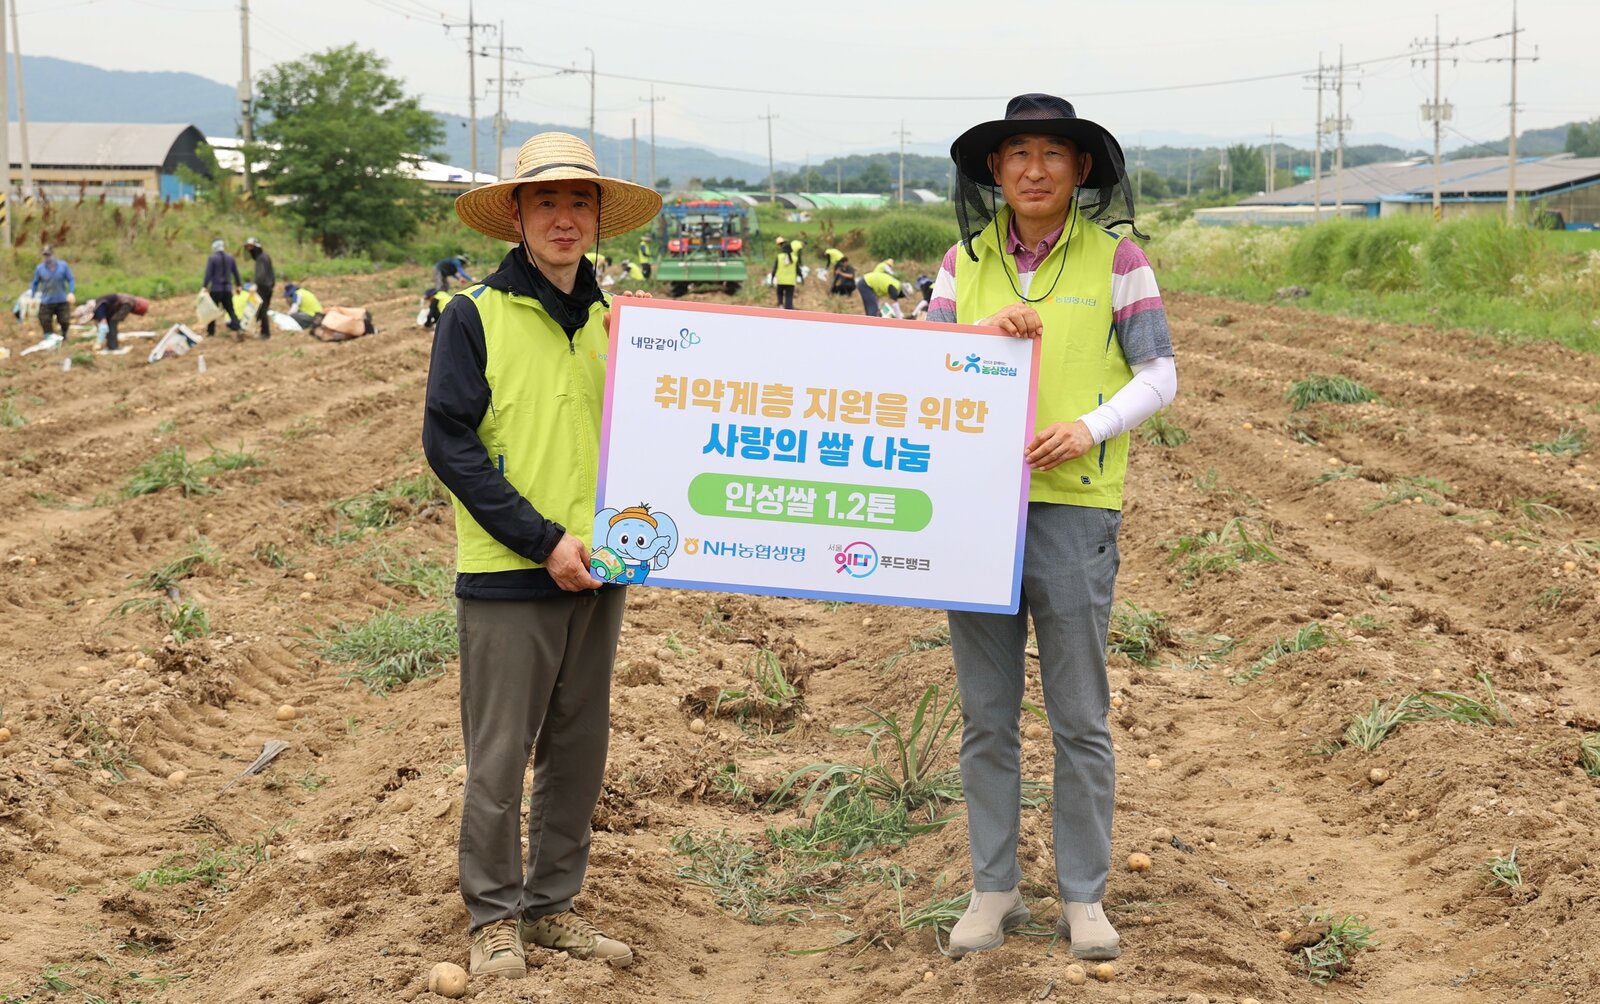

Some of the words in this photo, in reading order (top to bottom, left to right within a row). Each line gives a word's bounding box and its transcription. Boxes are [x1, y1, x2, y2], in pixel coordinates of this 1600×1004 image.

[631, 335, 678, 352] 내맘같이
[981, 364, 1018, 377] 농심천심
[654, 374, 794, 419] 취약계층
[803, 387, 907, 428] 지원을
[918, 396, 989, 434] 위한
[703, 423, 807, 464] 사랑의
[817, 431, 854, 468] 쌀
[862, 435, 931, 473] 나눔
[725, 481, 817, 517] 안성쌀
[824, 490, 896, 525] 1.2톤
[703, 541, 806, 563] NH농협생명
[828, 543, 843, 552] 서울
[879, 556, 931, 571] 푸드뱅크
